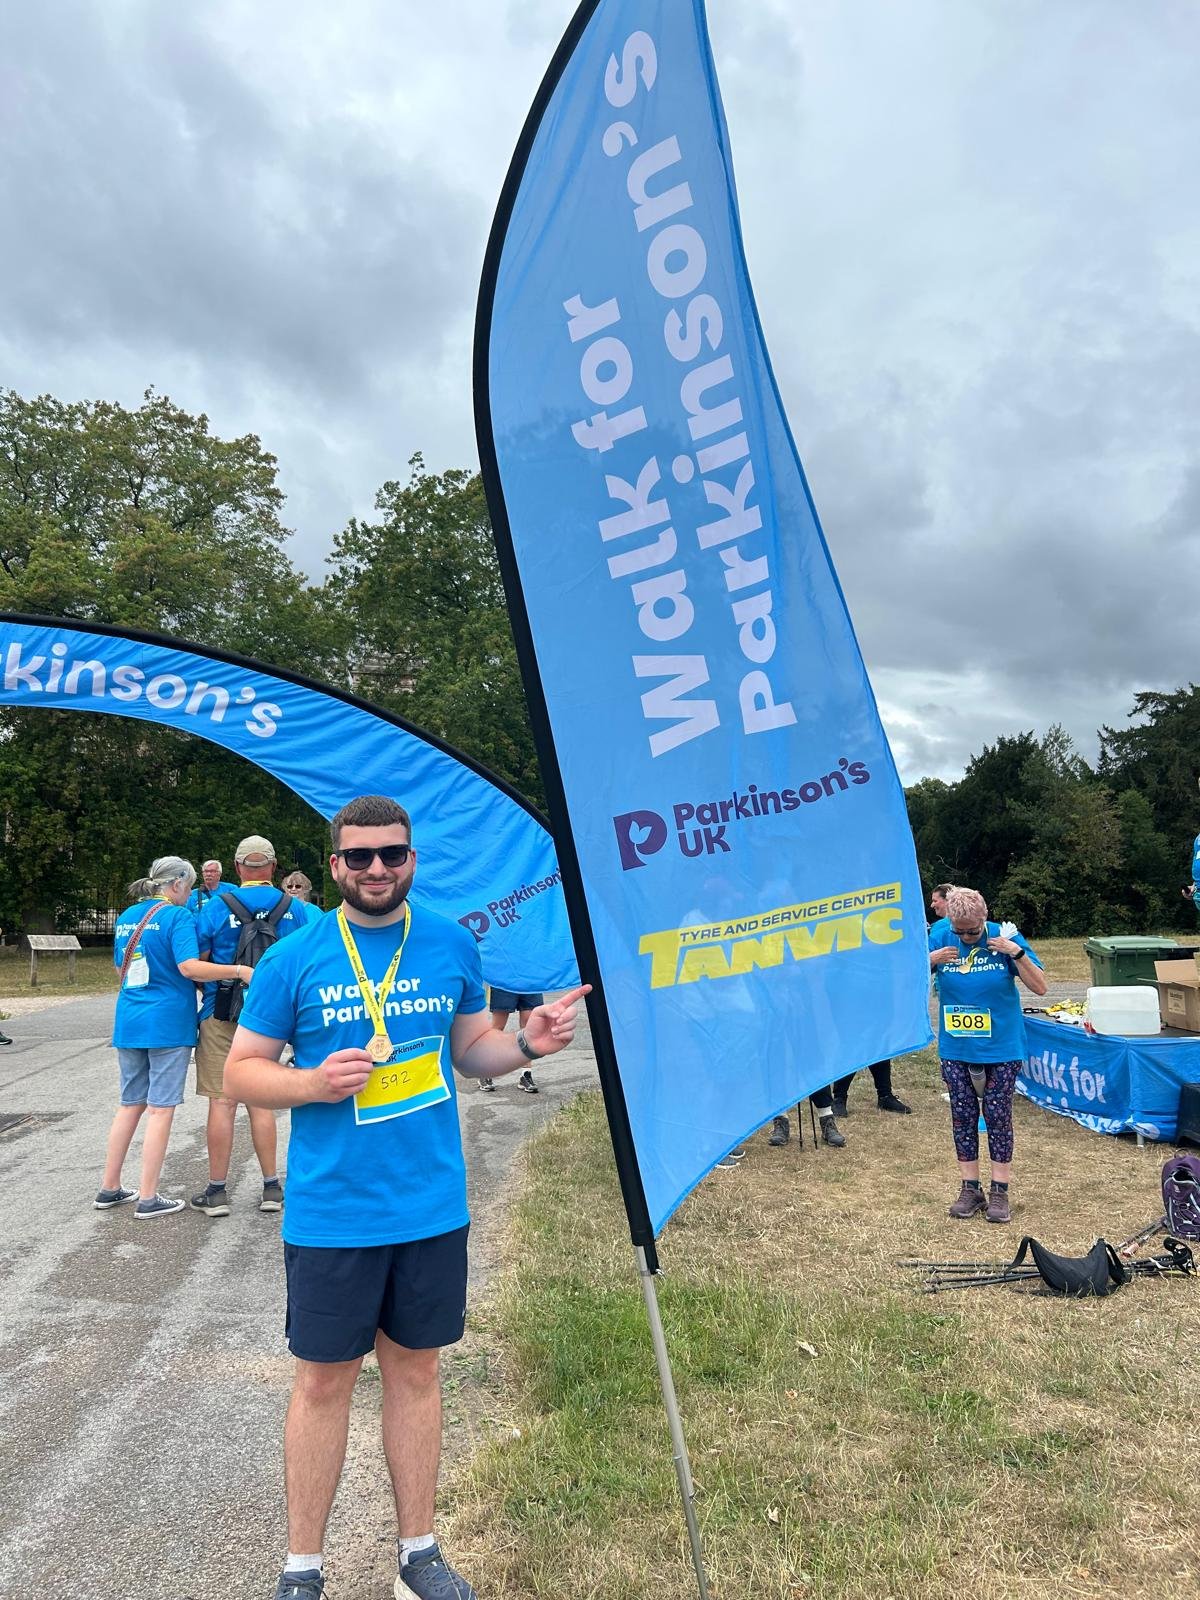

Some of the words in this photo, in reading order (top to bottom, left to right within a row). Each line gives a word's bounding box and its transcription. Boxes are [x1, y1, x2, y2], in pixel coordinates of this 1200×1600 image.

[563, 294, 648, 453] for
[603, 30, 798, 735] Parkinson's
[598, 455, 721, 758] Walk
[0, 642, 283, 738] kinson's
[673, 757, 870, 830] Parkinson's
[678, 826, 731, 857] UK
[495, 908, 522, 928] UK
[680, 927, 722, 943] TYRE
[723, 920, 759, 937] AND
[761, 903, 828, 928] SERVICE
[831, 888, 896, 911] CENTRE
[638, 907, 904, 990] TANVIC
[973, 956, 988, 965] for
[951, 1014, 984, 1029] 508
[381, 1070, 412, 1090] 592
[1069, 1056, 1107, 1104] for
